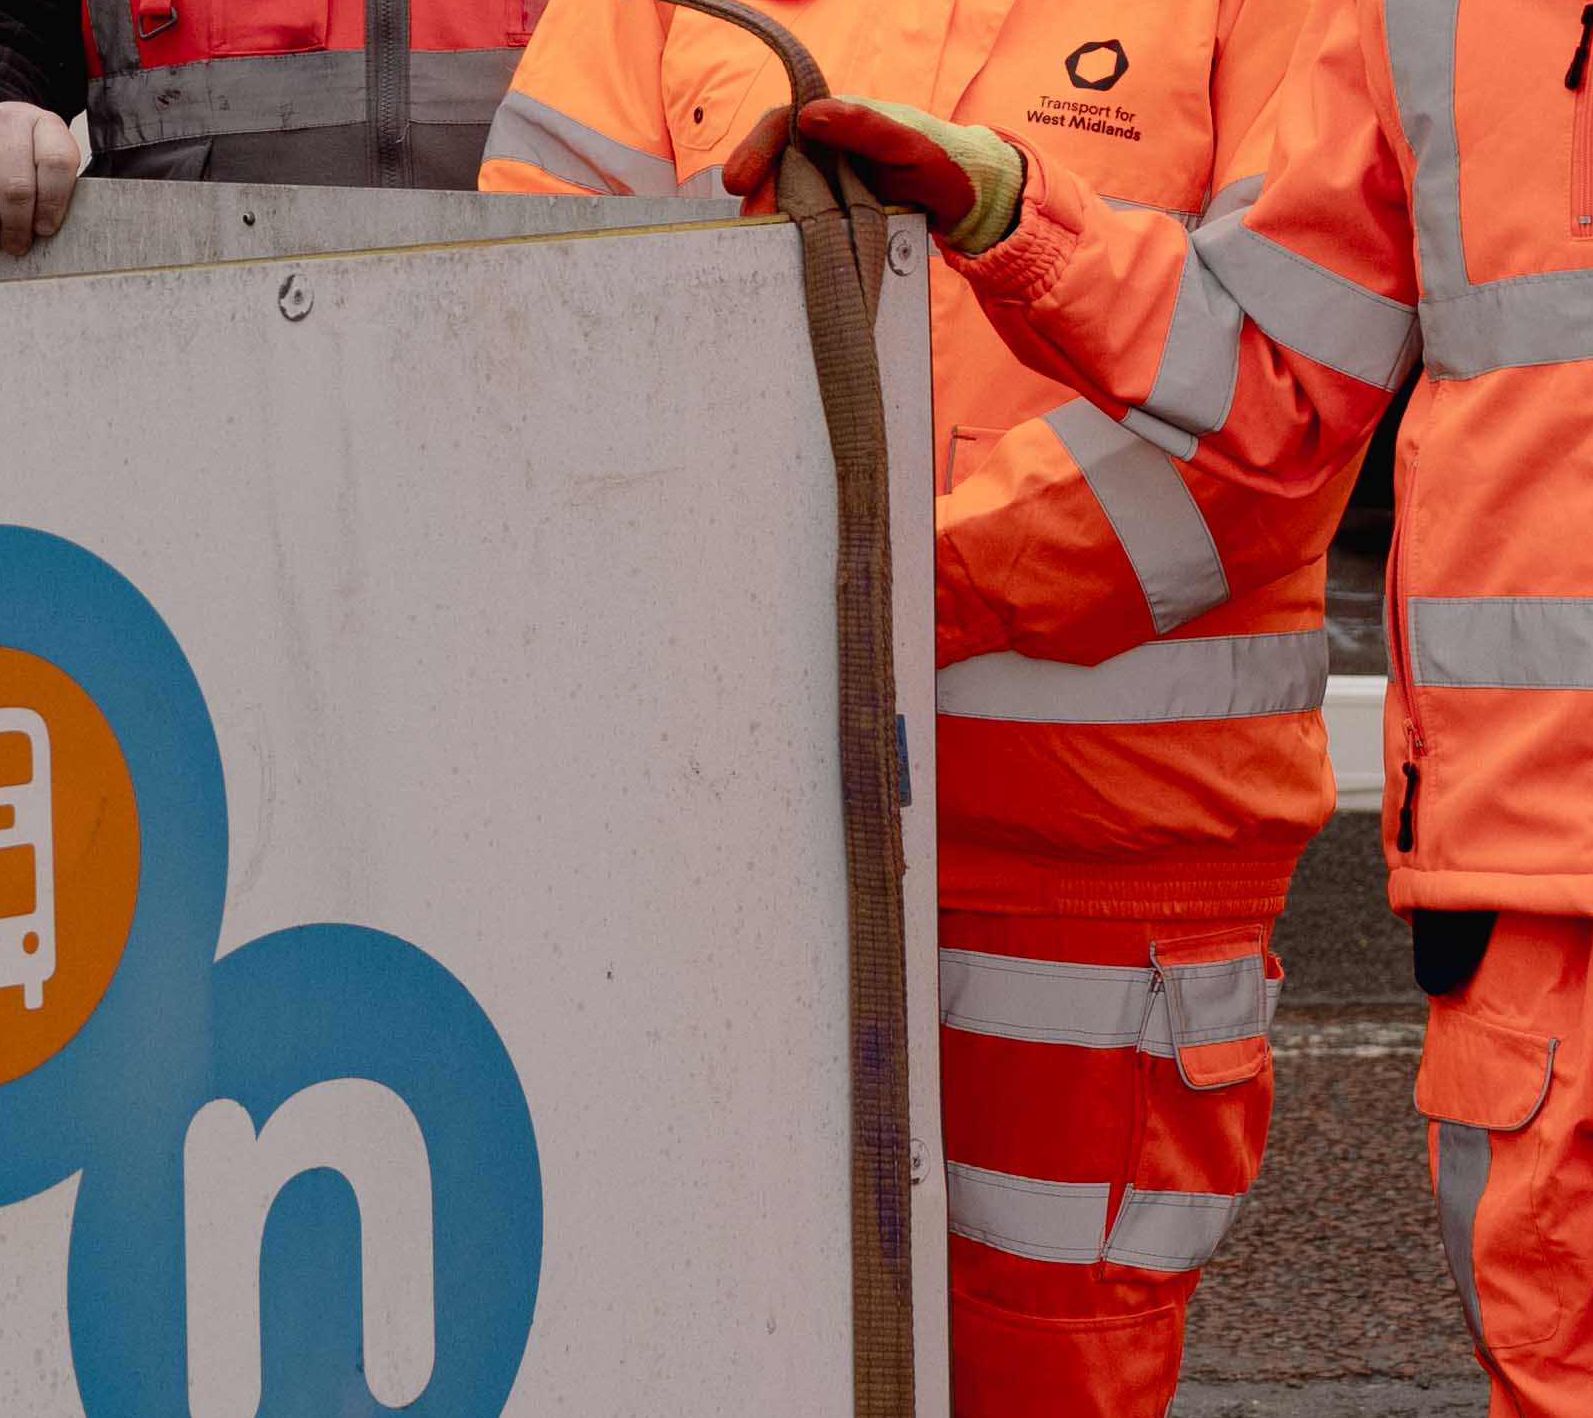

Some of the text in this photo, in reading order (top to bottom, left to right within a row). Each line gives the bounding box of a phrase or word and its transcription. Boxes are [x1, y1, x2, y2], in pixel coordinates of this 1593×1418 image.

[1040, 96, 1136, 123] Transport for
[1027, 110, 1142, 142] West Midlands
